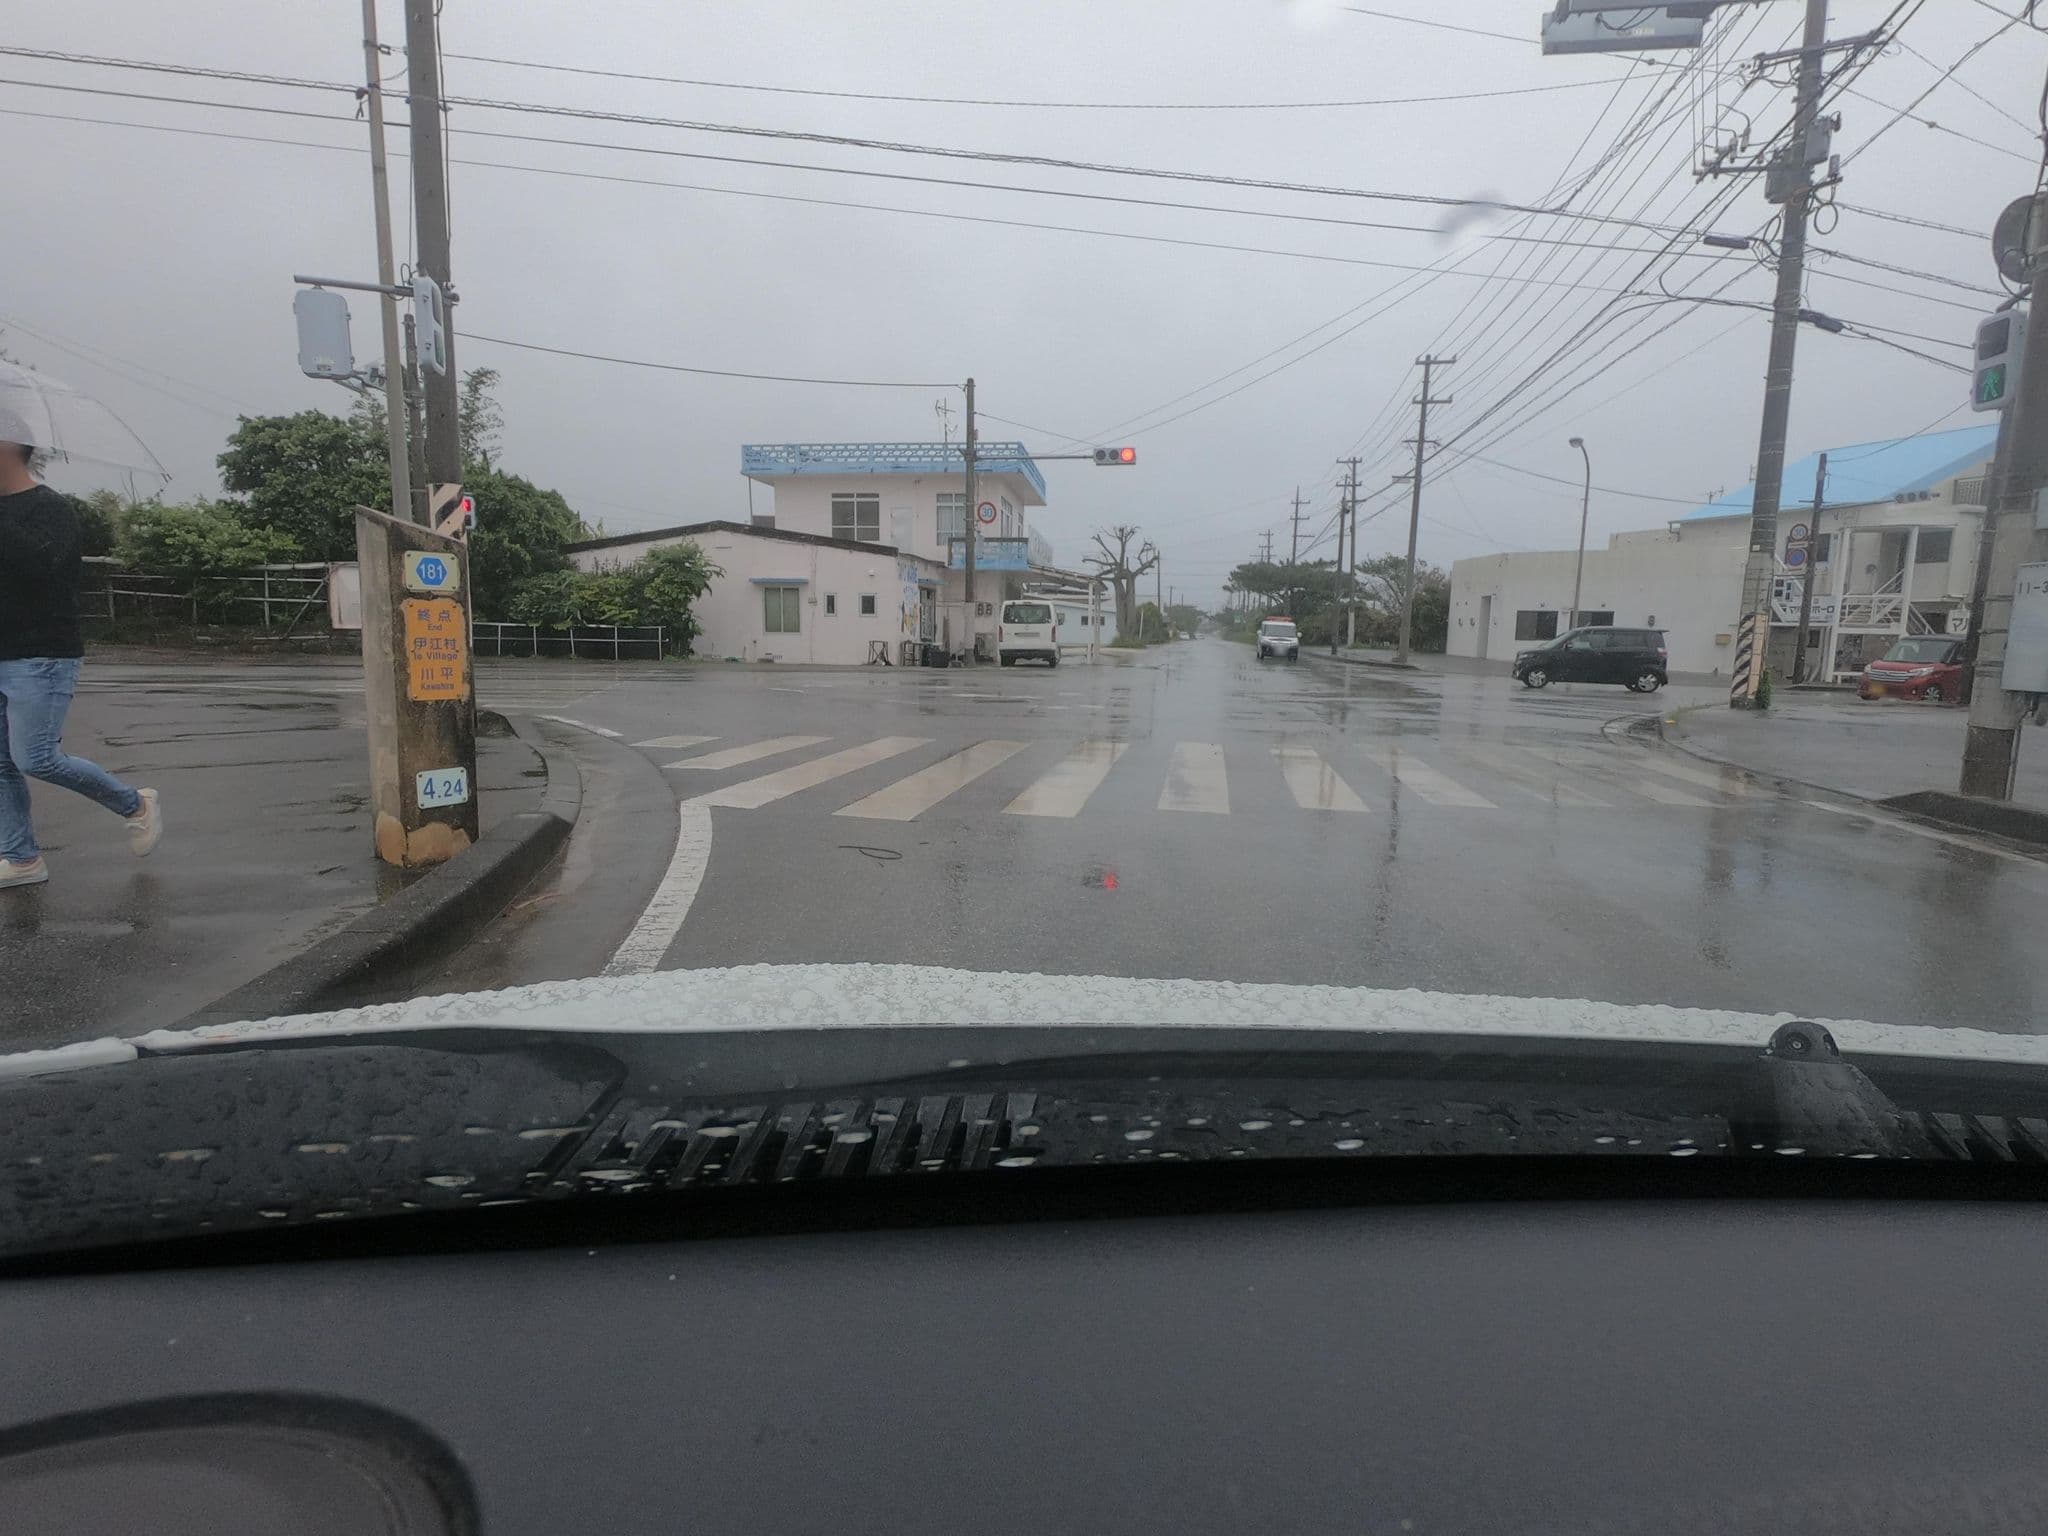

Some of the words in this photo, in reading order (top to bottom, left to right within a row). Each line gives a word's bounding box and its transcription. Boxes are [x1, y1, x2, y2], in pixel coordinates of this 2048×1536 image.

[982, 507, 993, 517] 30
[419, 563, 443, 580] 181
[417, 608, 451, 622] 終点
[427, 624, 443, 632] End
[414, 638, 456, 650] 伊江村
[426, 651, 458, 662] Village
[421, 667, 454, 681] 川平
[423, 777, 463, 800] 4.24
